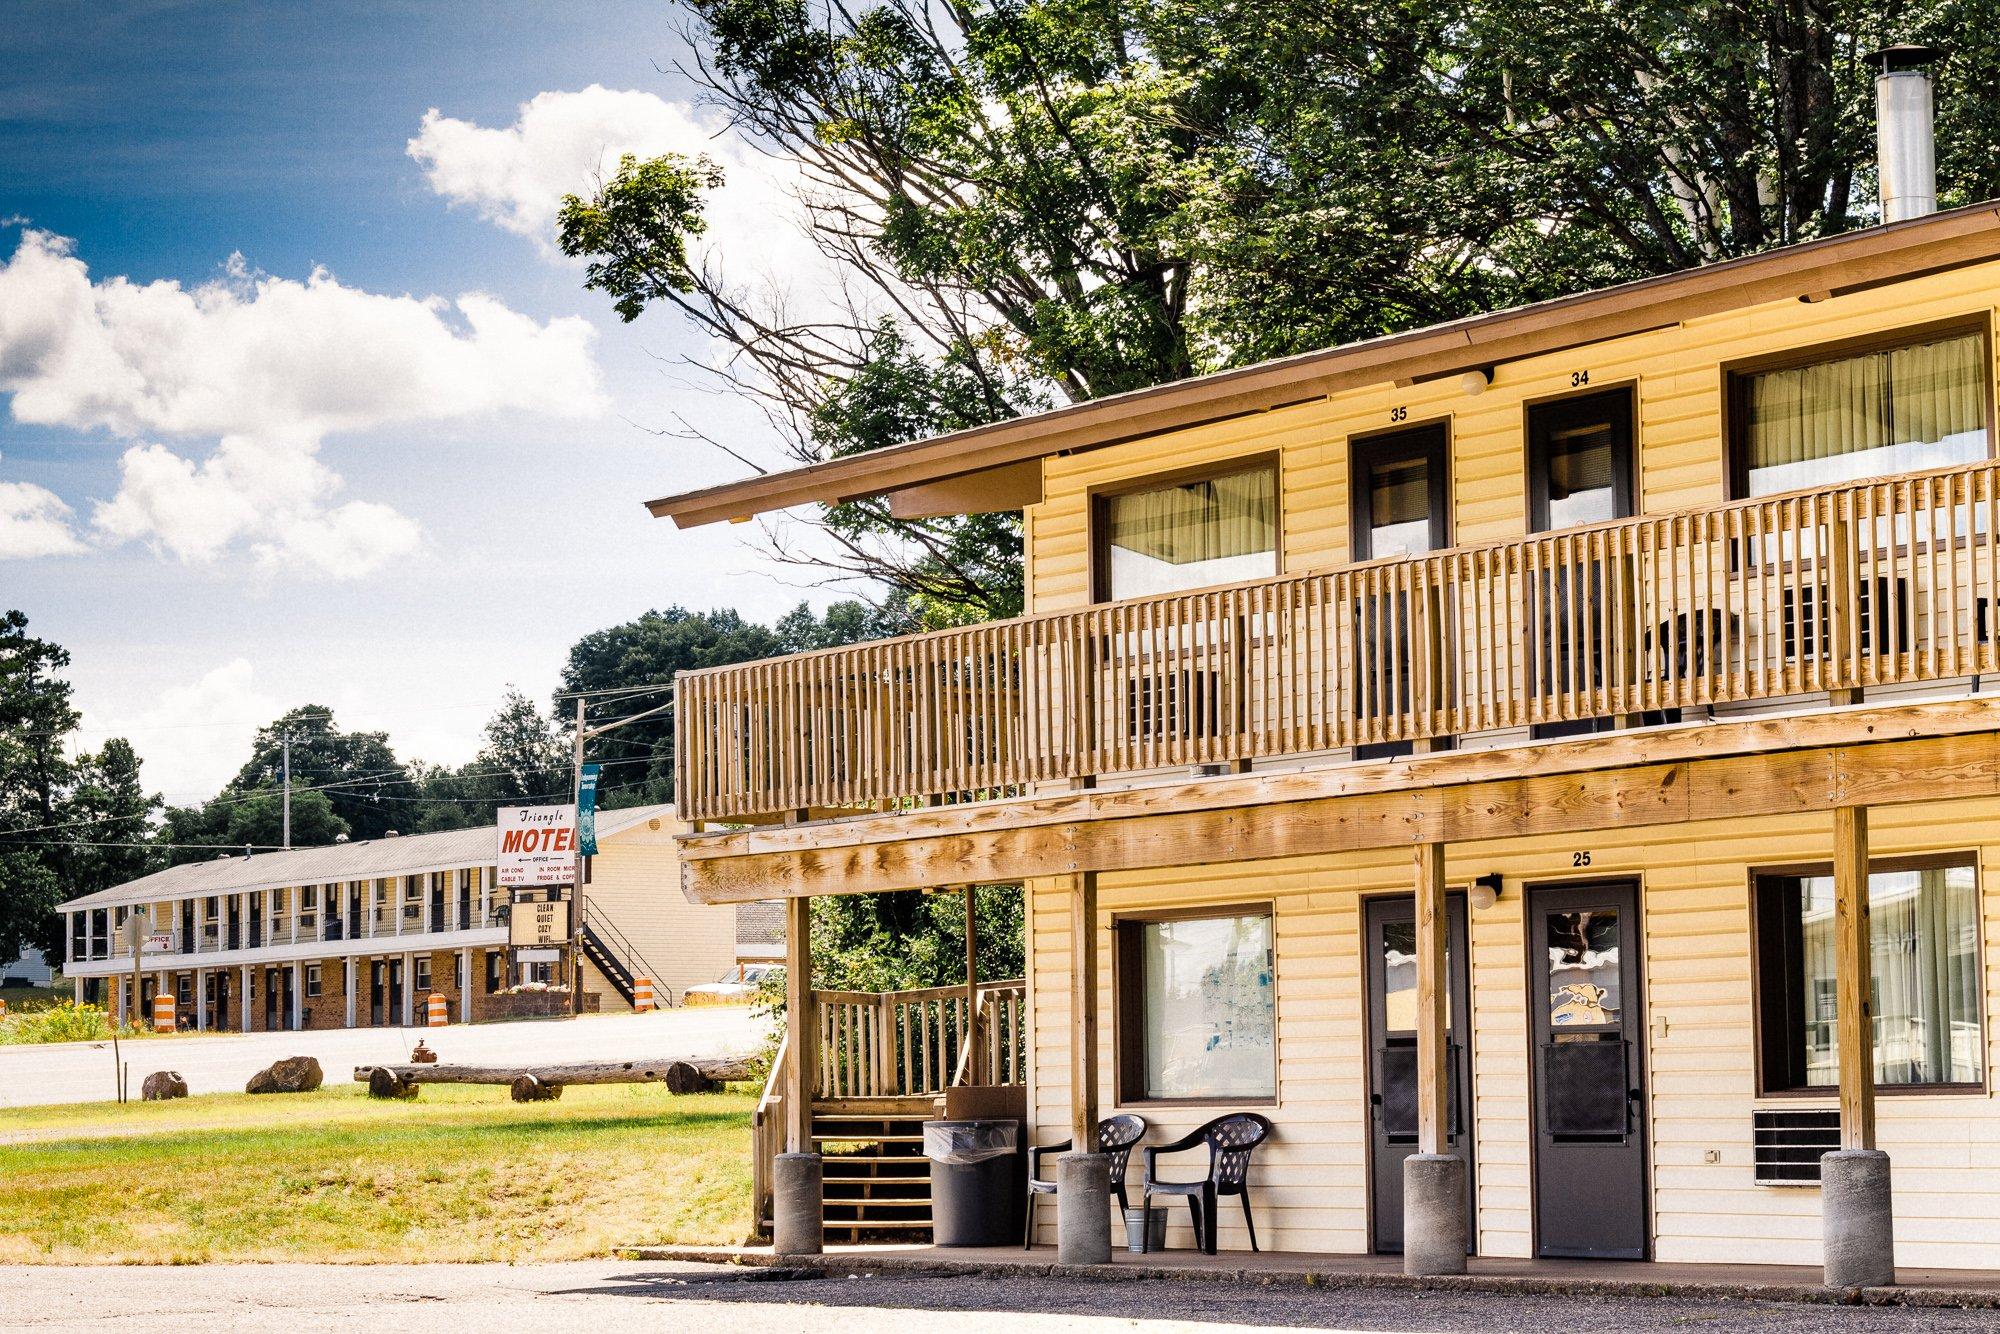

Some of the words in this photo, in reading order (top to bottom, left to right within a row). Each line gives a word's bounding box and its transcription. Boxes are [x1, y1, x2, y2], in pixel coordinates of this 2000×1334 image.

[1571, 370, 1589, 387] 34
[1391, 406, 1407, 422] 35
[520, 809, 563, 825] Triangle
[1573, 851, 1591, 867] 25
[536, 904, 554, 912] CLEAN
[536, 915, 554, 923] QUIET
[538, 925, 552, 933] COZY
